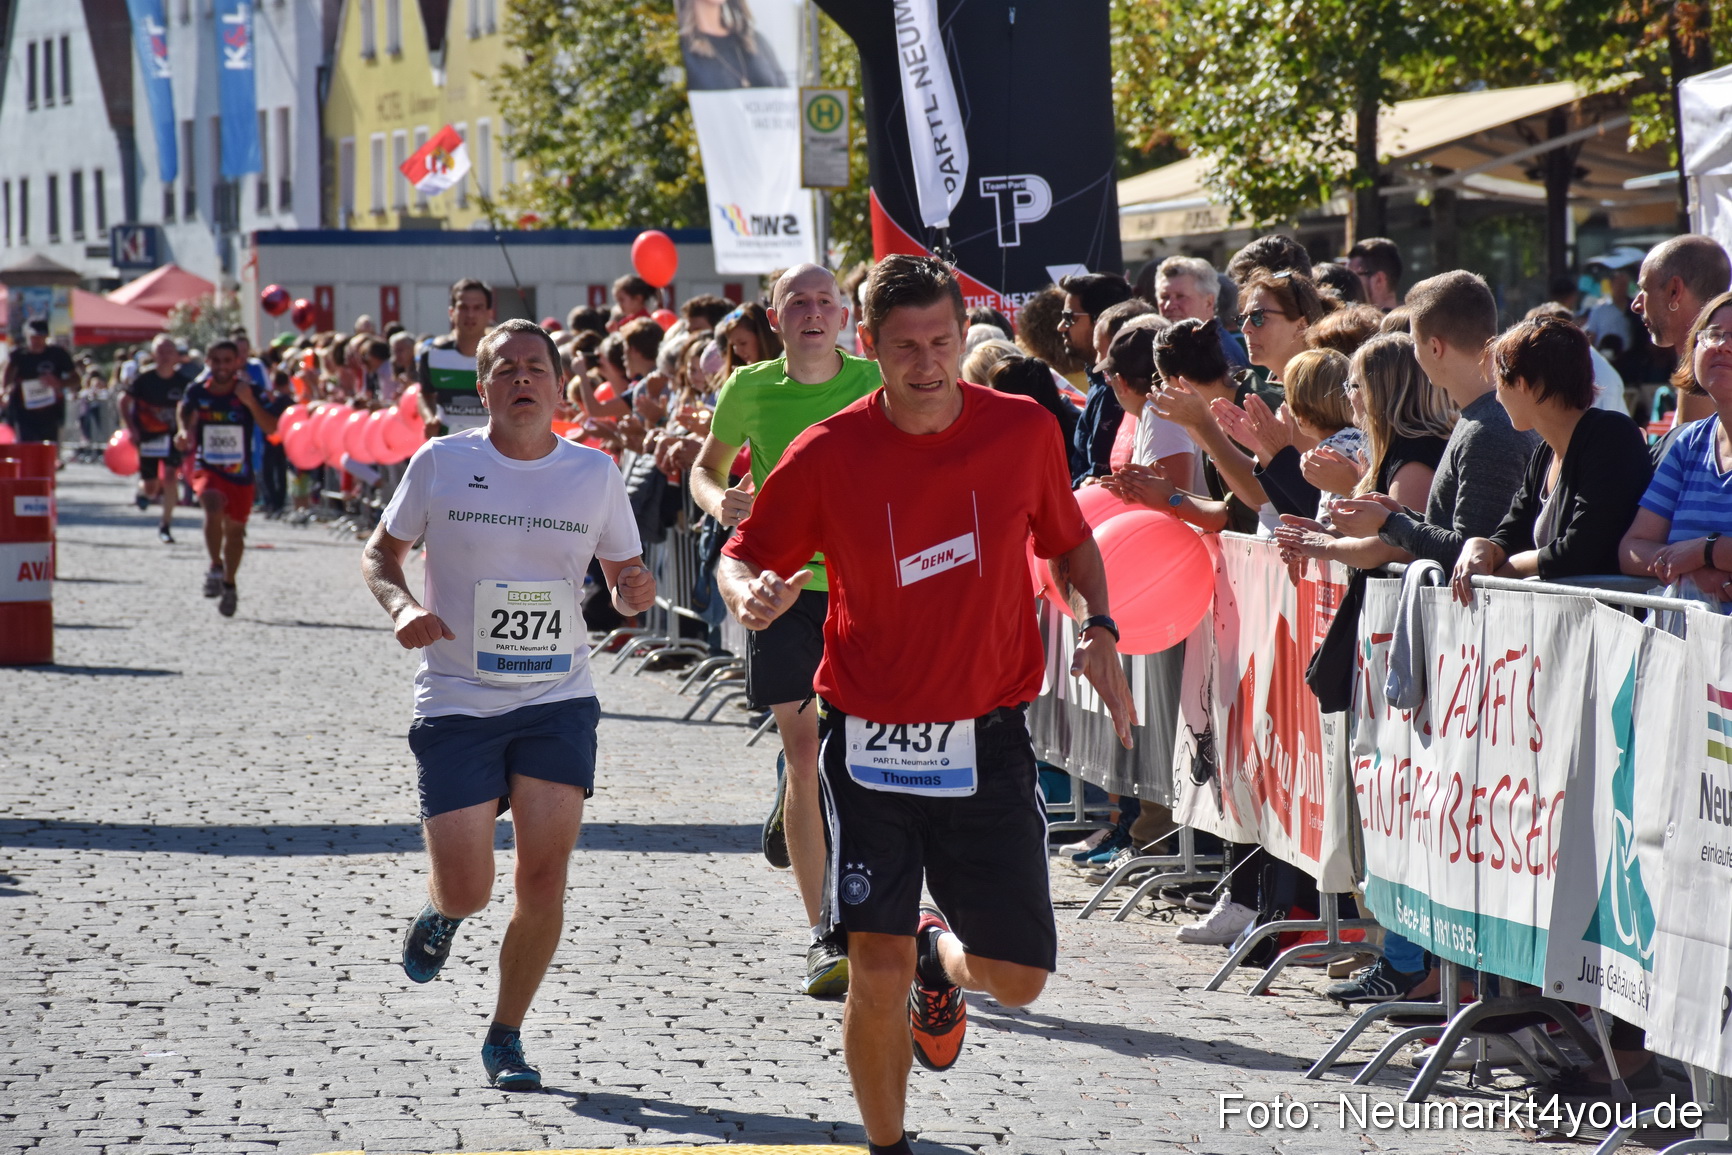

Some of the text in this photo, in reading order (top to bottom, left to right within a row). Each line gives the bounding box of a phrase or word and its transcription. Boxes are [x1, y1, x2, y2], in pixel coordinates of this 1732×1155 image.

[964, 294, 997, 311] THE
[468, 482, 489, 490] erima
[448, 509, 589, 535] RUPPRECHT HOLZBAU
[921, 548, 955, 571] DEHN
[508, 591, 552, 602] BOCK
[490, 609, 562, 640] 2374
[496, 643, 518, 651] PARTL
[497, 657, 553, 671] Bernhard
[865, 720, 956, 753] 2437
[873, 757, 938, 766] PARTL Neumarkt
[880, 771, 942, 786] Thomas
[1577, 955, 1604, 988] Jura
